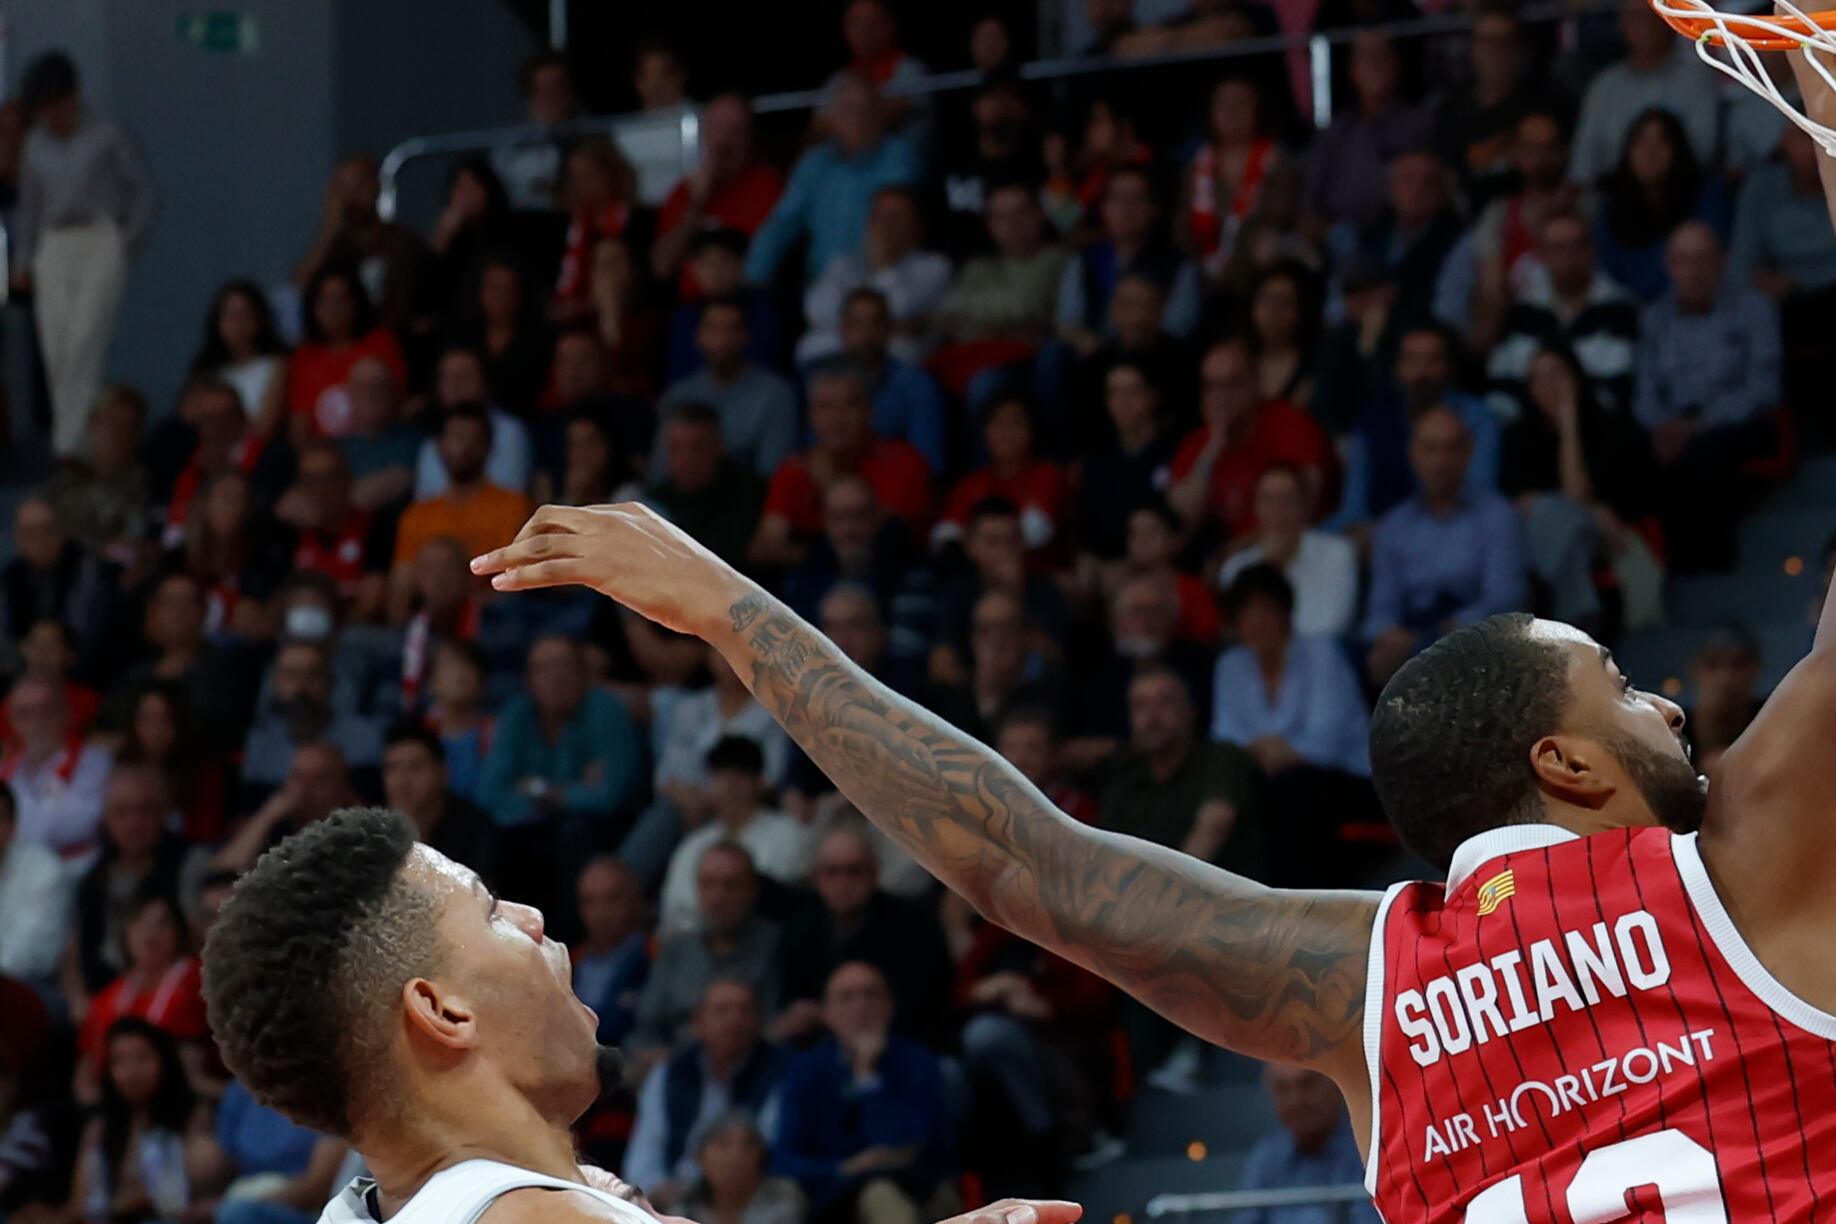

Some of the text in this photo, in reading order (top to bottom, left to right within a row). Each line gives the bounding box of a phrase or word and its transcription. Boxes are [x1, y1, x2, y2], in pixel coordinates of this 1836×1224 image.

[1394, 909, 1671, 1068] SORIANO
[1423, 1027, 1716, 1163] AIR HORIZONT
